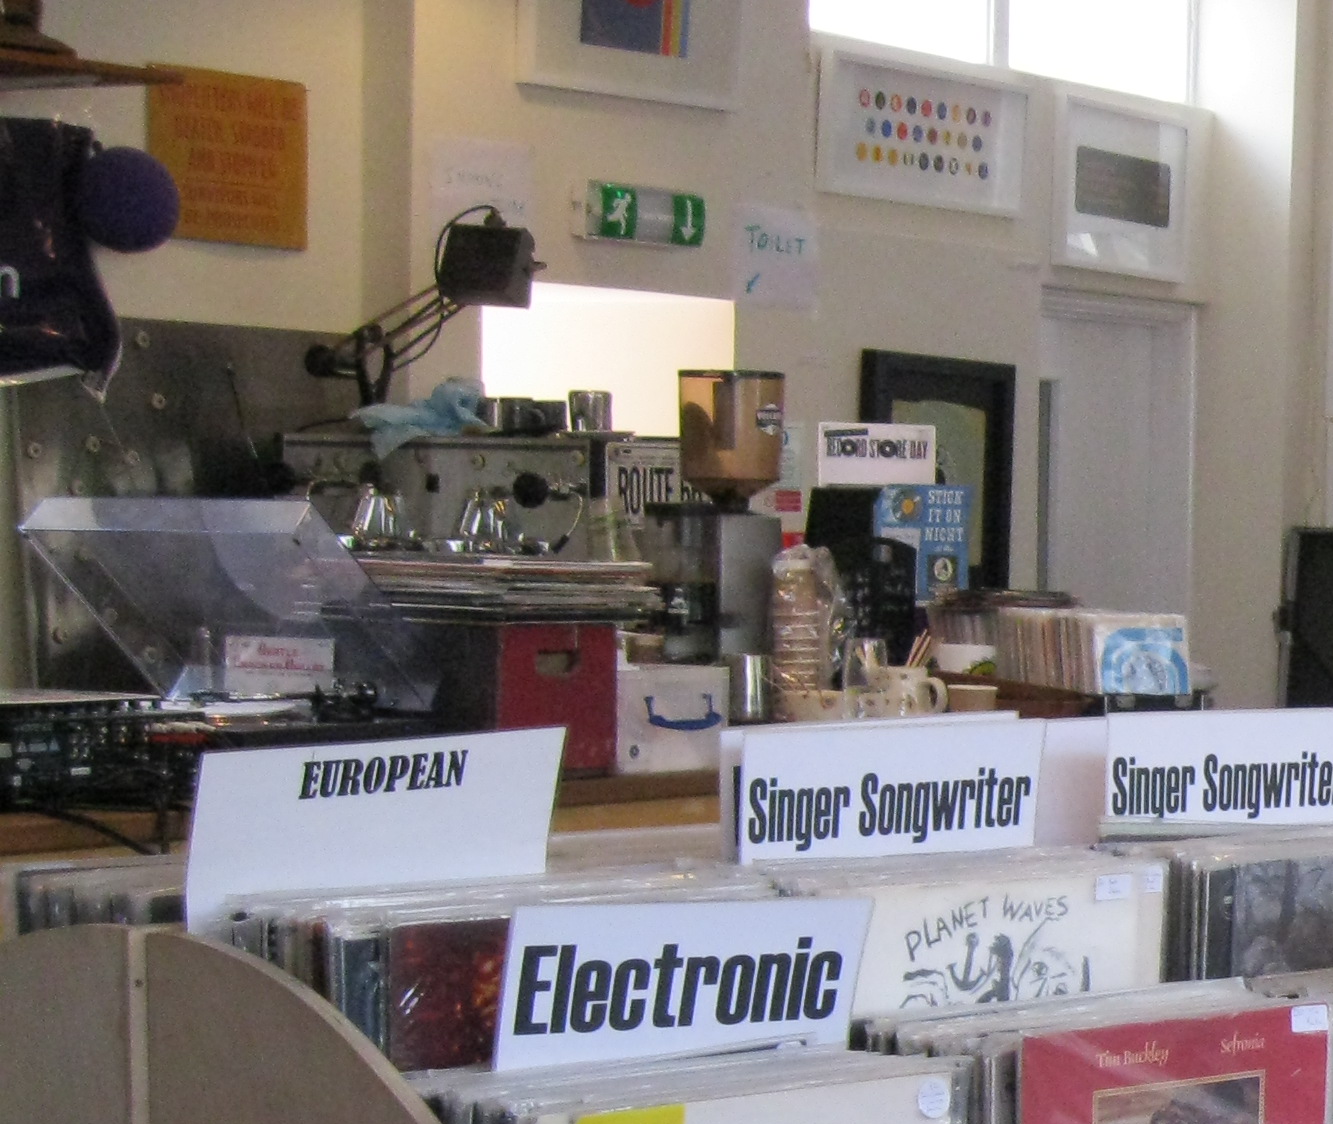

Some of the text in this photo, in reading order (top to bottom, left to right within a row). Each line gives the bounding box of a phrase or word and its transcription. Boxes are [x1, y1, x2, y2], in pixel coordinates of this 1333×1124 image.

[744, 224, 806, 255] TOILET
[825, 439, 929, 460] RECORD STORE DAY
[617, 466, 676, 516] ROUTE
[927, 489, 965, 505] STICK
[924, 526, 964, 543] NIGHT
[928, 508, 962, 523] IT ON
[298, 749, 469, 801] EUROPEAN
[1111, 755, 1197, 818] Singer
[747, 765, 1032, 853] Singer Songwriter
[904, 893, 1070, 962] PLANET WAVES
[511, 935, 844, 1037] Electronic
[1096, 1031, 1267, 1069] Tim Buckley Sefronia
